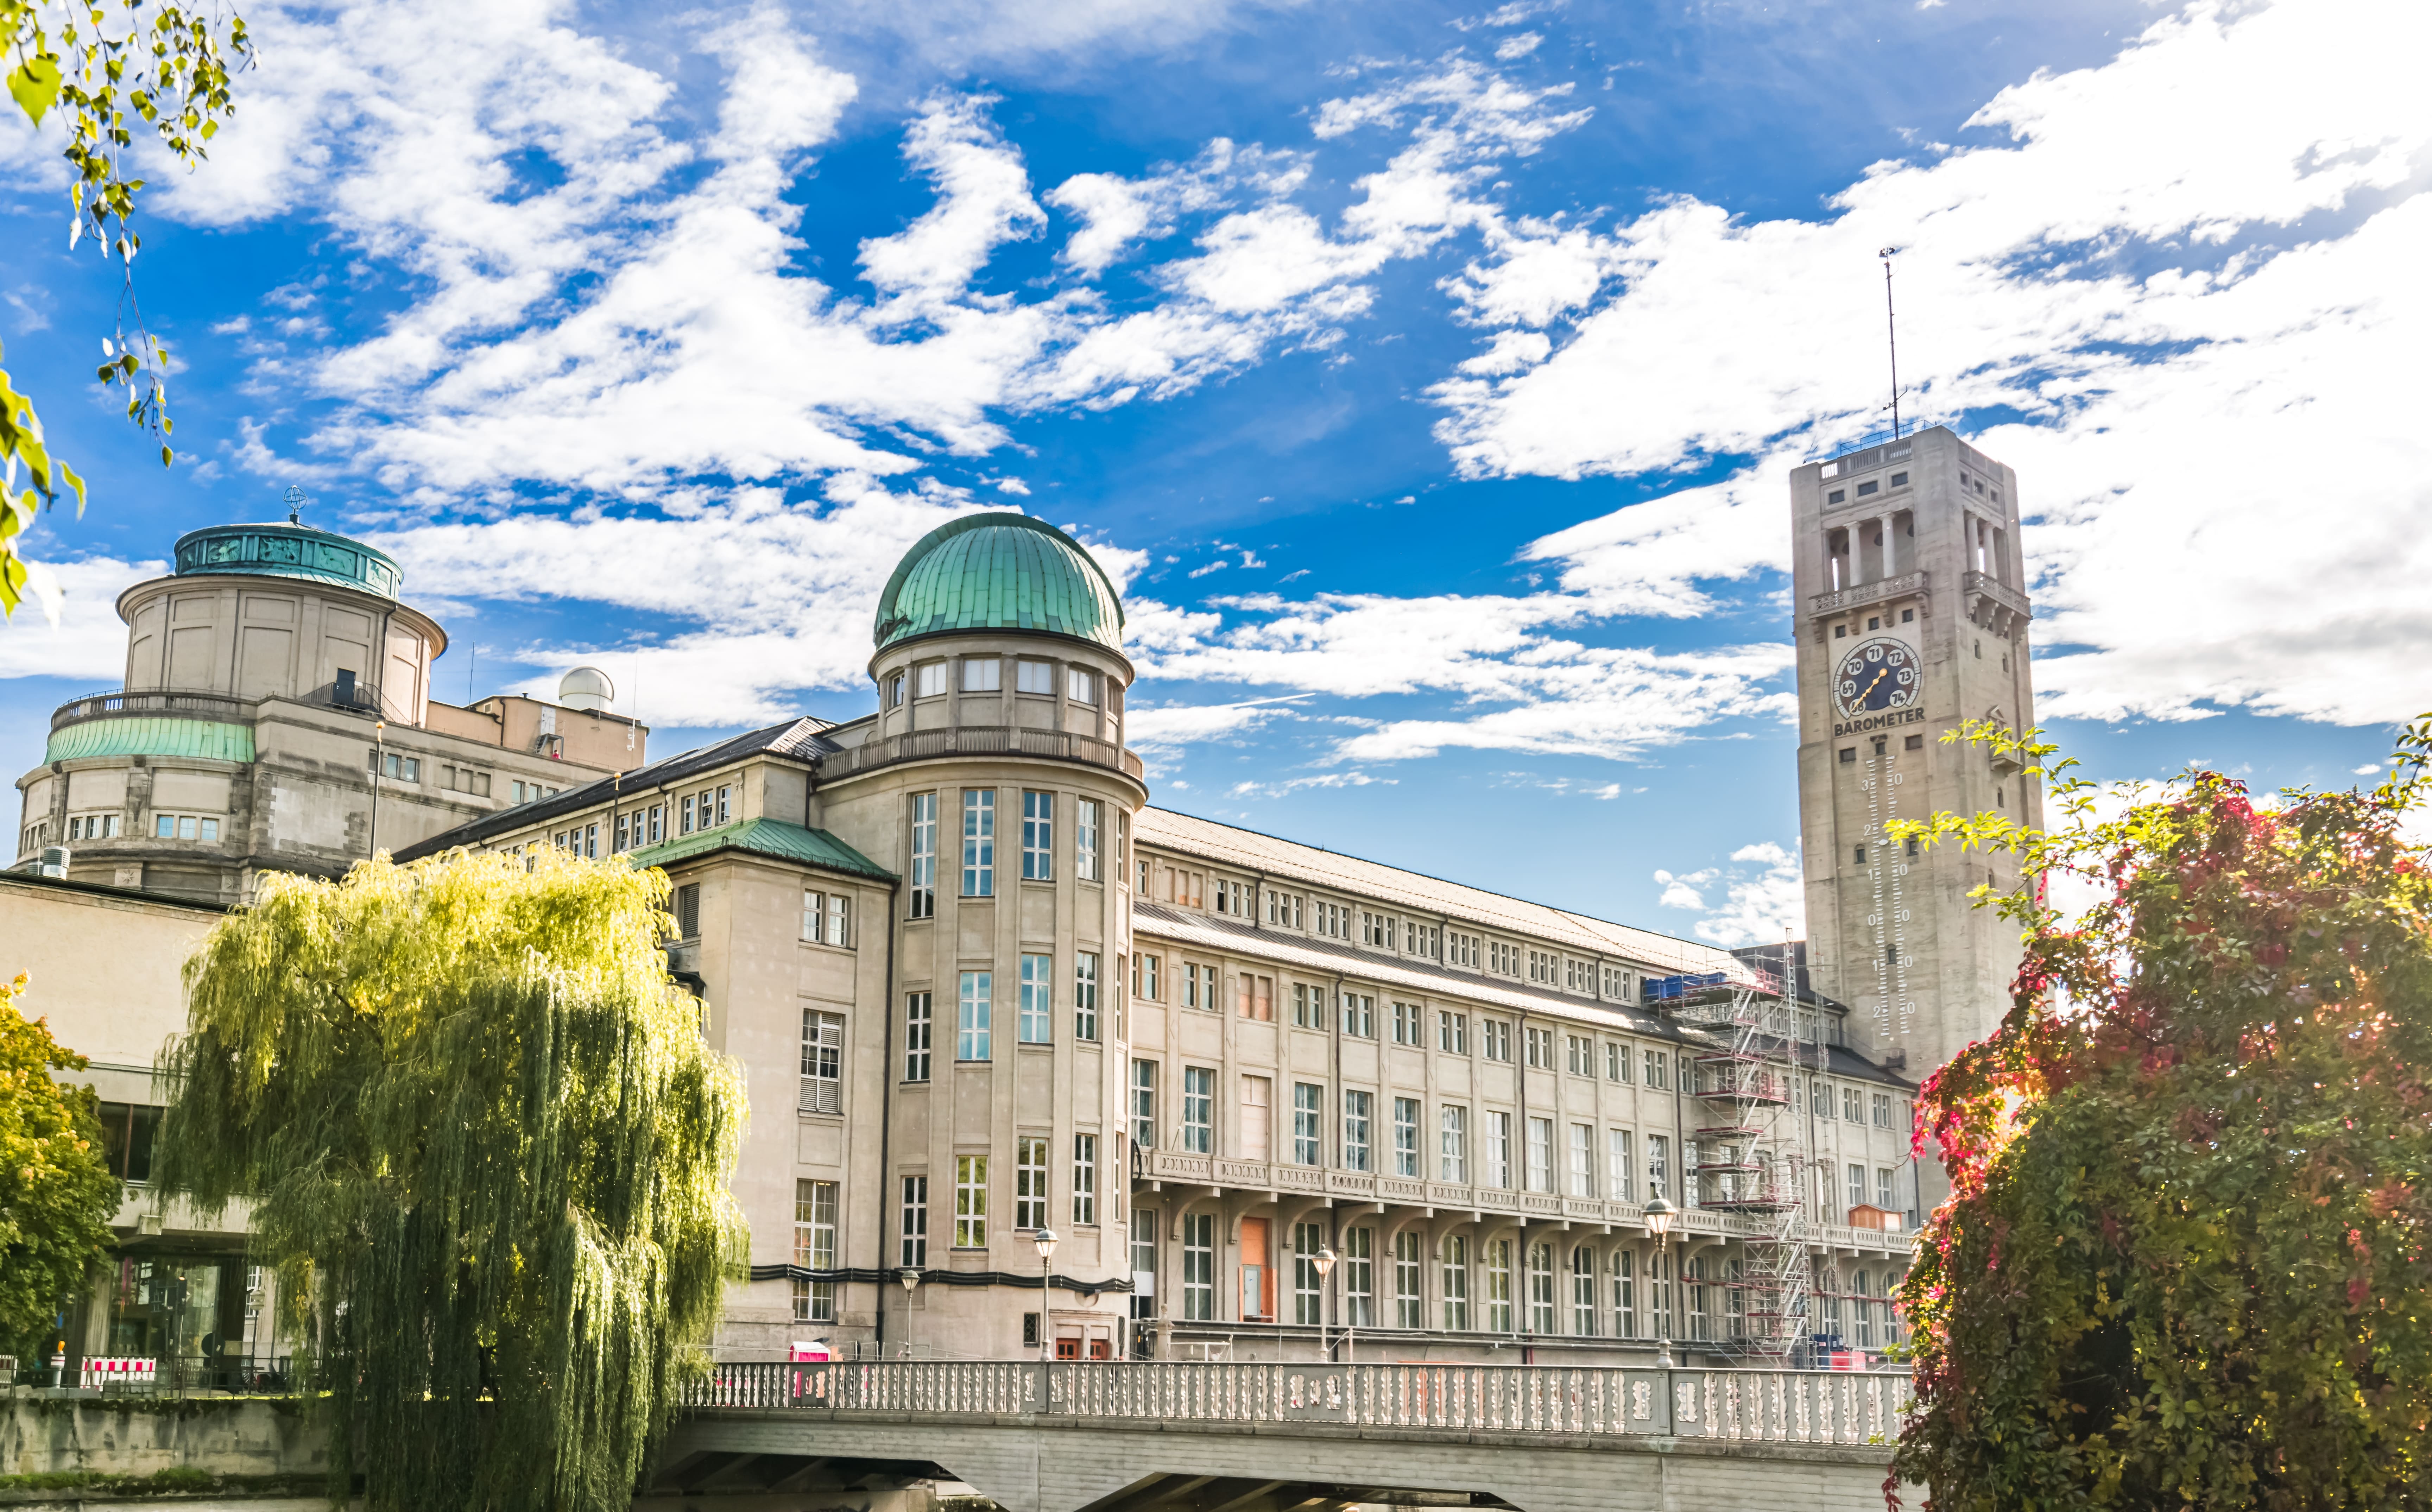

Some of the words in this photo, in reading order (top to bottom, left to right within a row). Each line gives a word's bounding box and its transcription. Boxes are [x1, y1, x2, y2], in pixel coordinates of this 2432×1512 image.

[1869, 649, 1879, 659] 71
[1889, 652, 1902, 663] 72
[1849, 662, 1861, 672] 70
[1899, 670, 1911, 681] 73
[1843, 683, 1853, 694] 69
[1891, 693, 1905, 704] 74
[1834, 707, 1925, 736] BAROMETER
